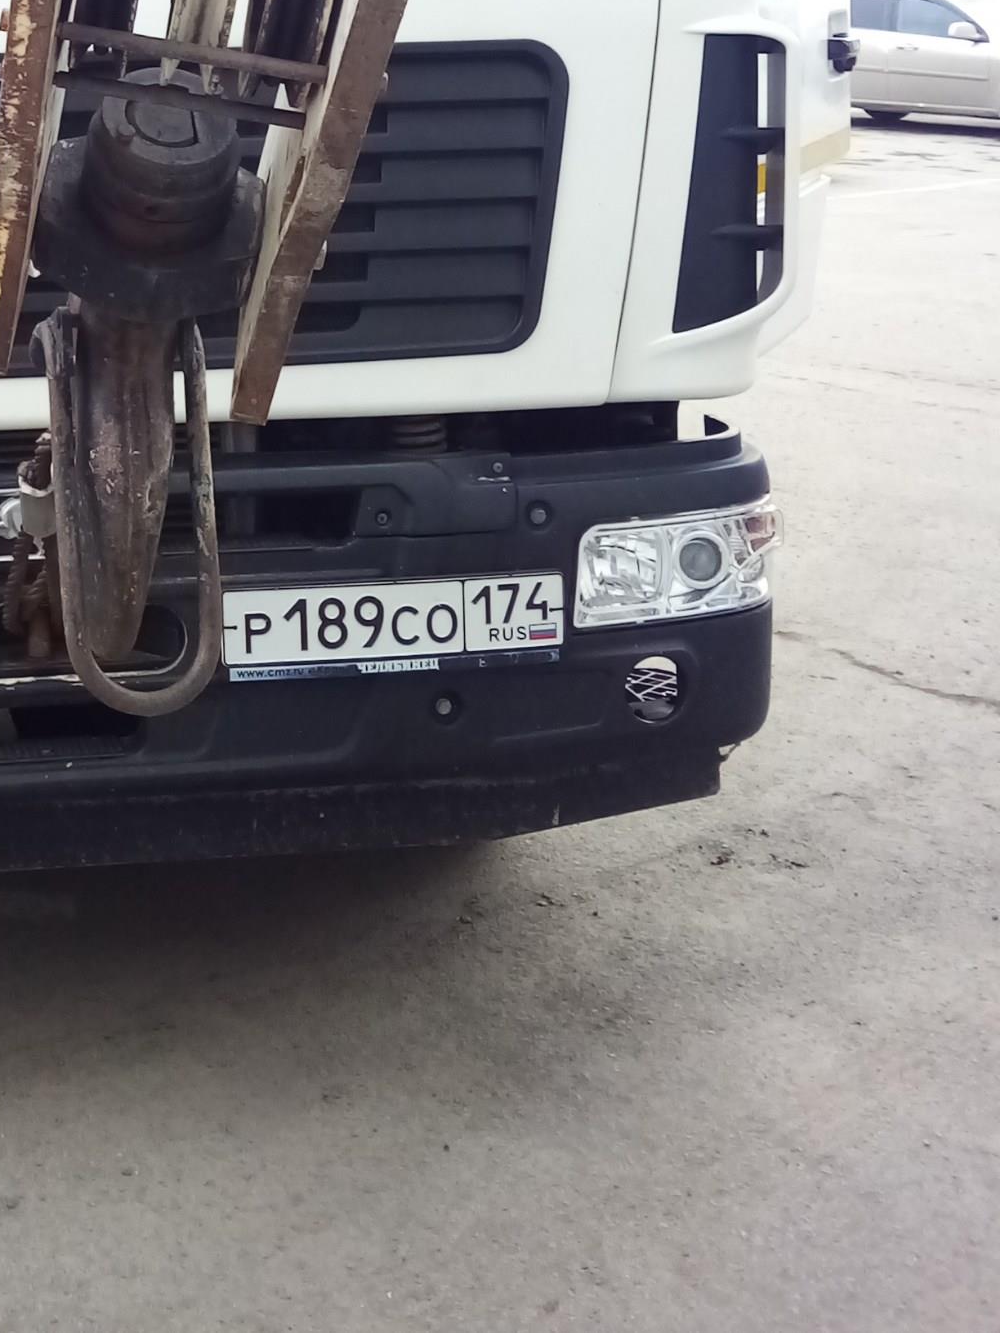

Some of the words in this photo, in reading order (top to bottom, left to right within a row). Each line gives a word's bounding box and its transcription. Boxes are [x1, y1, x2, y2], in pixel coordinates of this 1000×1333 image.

[243, 595, 458, 654] Р189СО
[471, 581, 549, 624] 174
[488, 625, 528, 642] RUS
